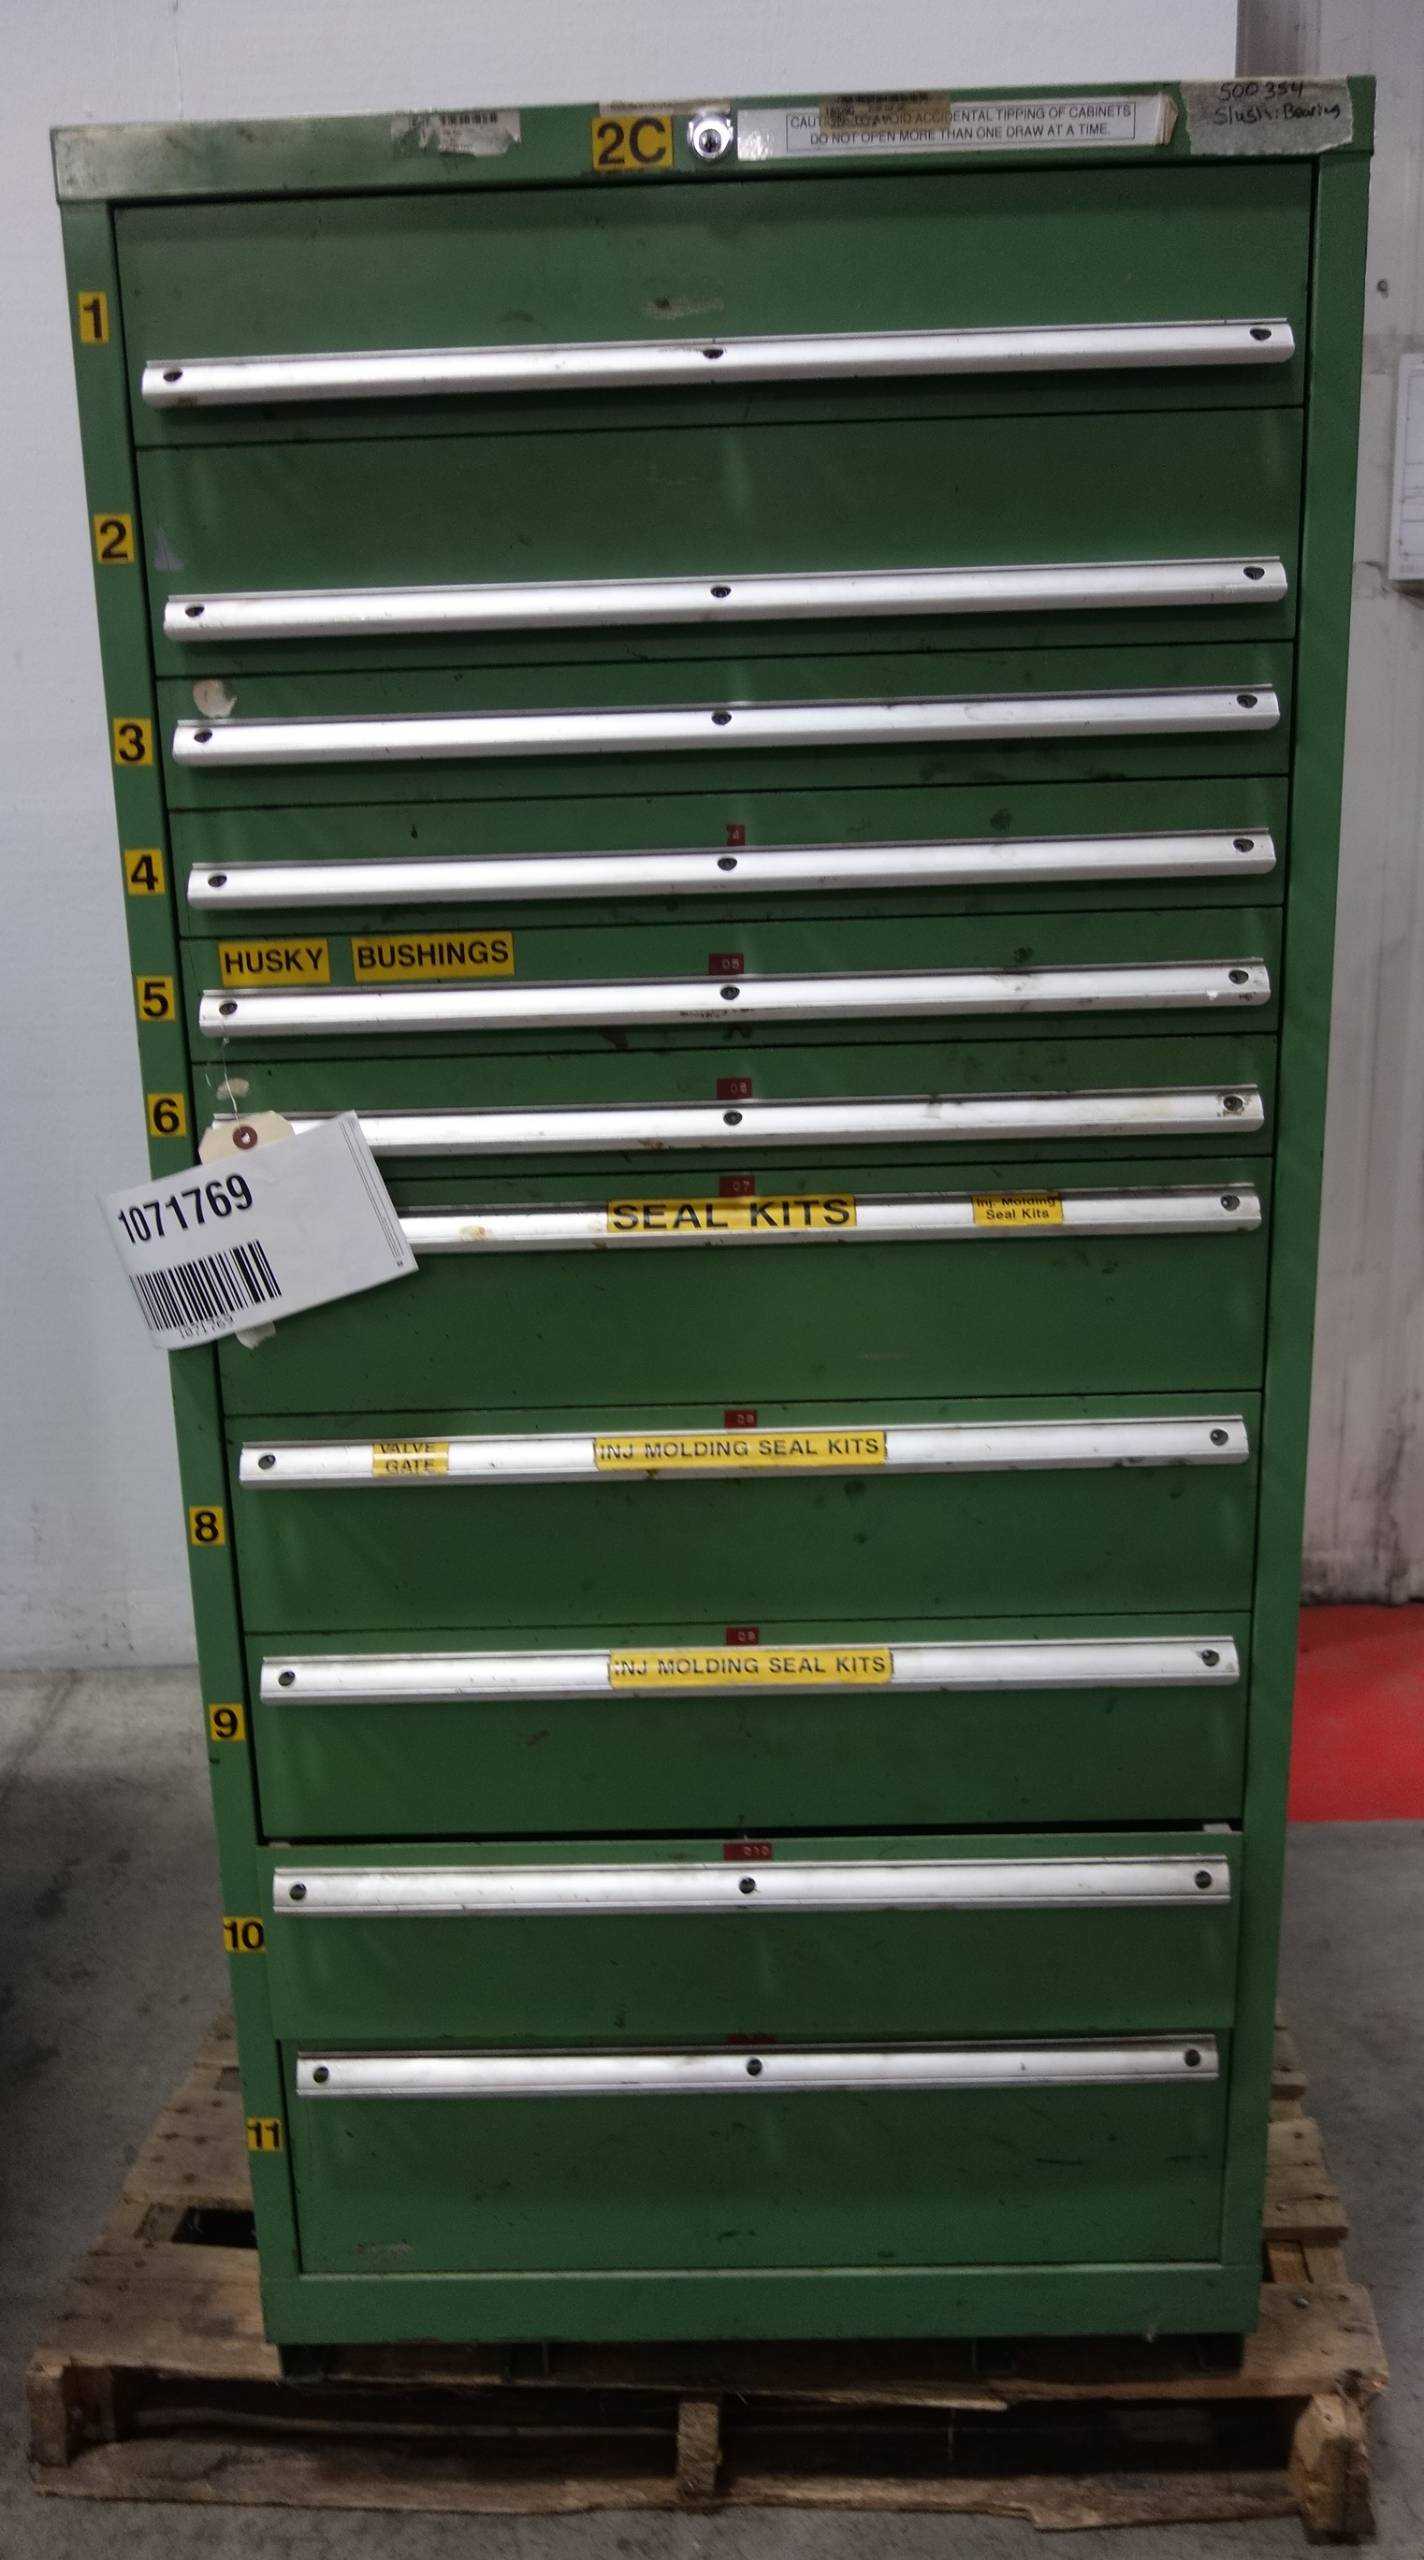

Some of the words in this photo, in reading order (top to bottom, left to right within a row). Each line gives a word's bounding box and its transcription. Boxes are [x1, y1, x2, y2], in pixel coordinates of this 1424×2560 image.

[915, 106, 993, 124] ACCIDENTAL
[997, 106, 1045, 121] TIPPING
[1049, 105, 1065, 118] OF
[1069, 103, 1131, 117] CABINETS
[597, 117, 667, 165] 2C
[810, 133, 829, 146] DO
[832, 132, 857, 145] NOT
[861, 131, 896, 143] OPEN
[900, 129, 936, 142] MORE
[941, 127, 973, 140] THAN
[976, 126, 1002, 139] ONE
[1006, 124, 1045, 137] DRAW
[1048, 124, 1063, 136] AT
[1066, 123, 1075, 136] A
[83, 298, 103, 338] 1
[99, 519, 129, 560] 2
[118, 723, 146, 762] 3
[130, 854, 158, 891] 4
[224, 947, 323, 973] HUSKY
[357, 940, 509, 968] BUSHINGS
[143, 981, 169, 1017] 5
[152, 1098, 179, 1133] 6
[117, 1173, 253, 1244] 1071769
[613, 1203, 728, 1230] SEAL
[750, 1198, 850, 1227] KITS
[986, 1209, 1016, 1220] Seal
[1022, 1208, 1049, 1219] Kits
[600, 1443, 634, 1460] INJ
[644, 1440, 749, 1458] MOLDING
[758, 1439, 818, 1455] SEAL
[828, 1437, 879, 1454] KITS
[195, 1511, 219, 1542] 8
[658, 1657, 759, 1674] MOLDING
[769, 1656, 825, 1673] SEAL
[836, 1655, 885, 1672] KITS
[213, 1708, 239, 1739] 9
[224, 1921, 264, 1949] 10
[247, 2121, 280, 2148] 11
